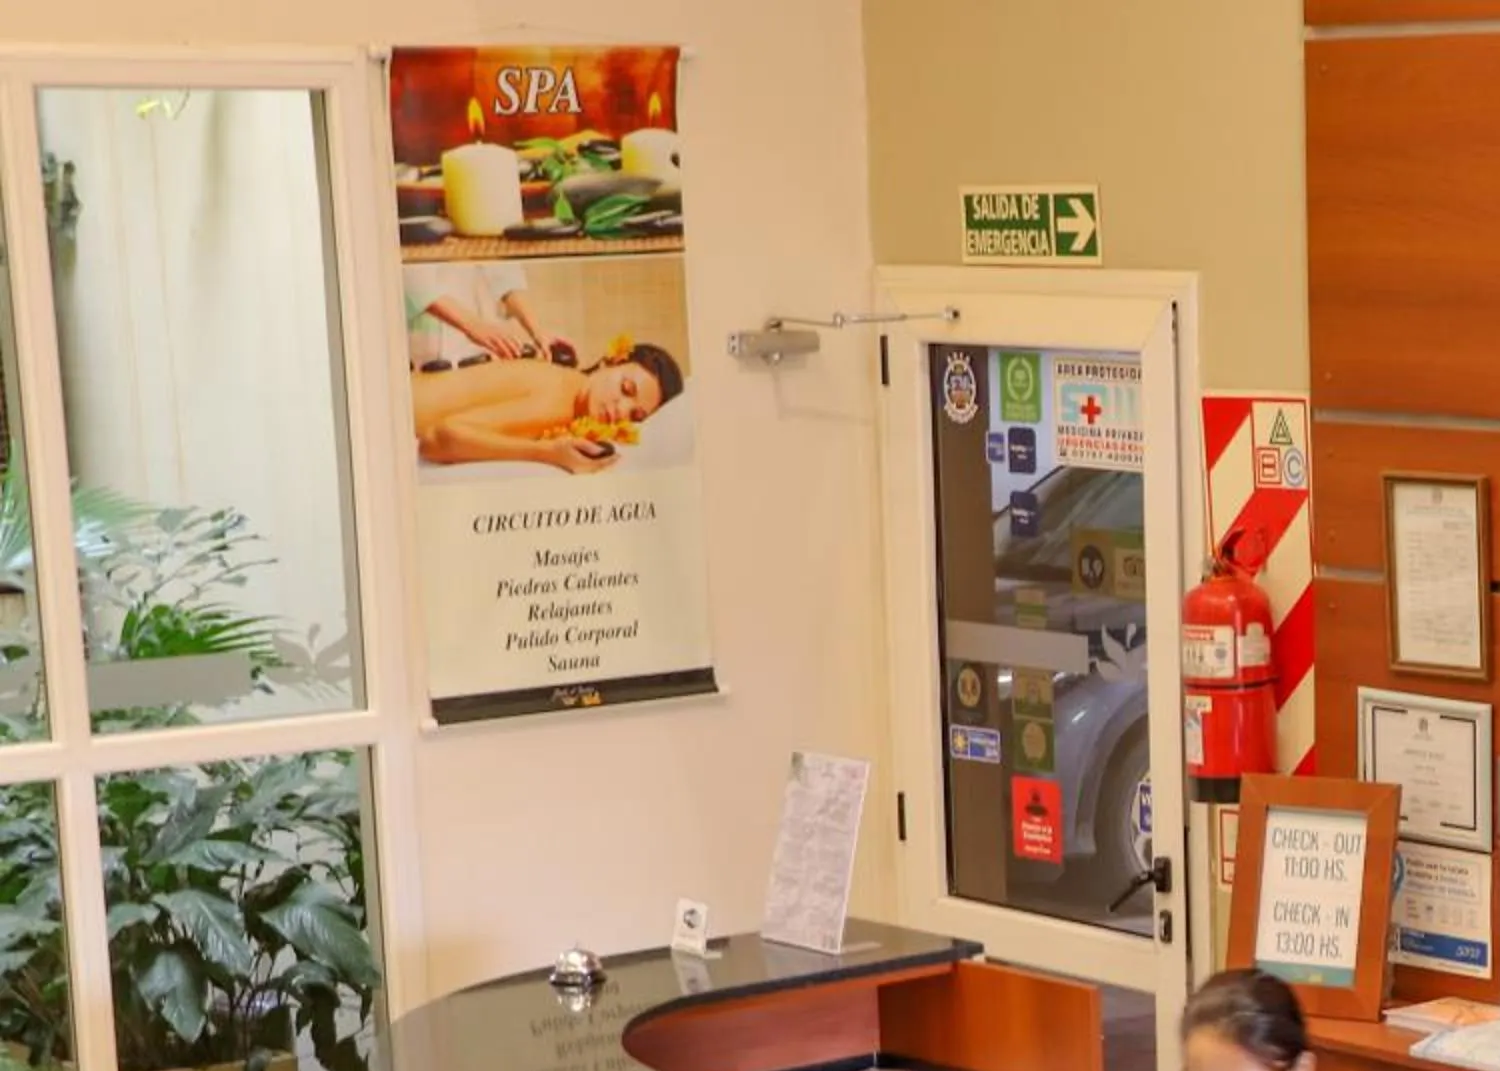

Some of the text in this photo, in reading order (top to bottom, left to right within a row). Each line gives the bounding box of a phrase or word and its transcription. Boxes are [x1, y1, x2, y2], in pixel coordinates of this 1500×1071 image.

[494, 65, 582, 115] SPA
[973, 194, 1040, 220] SALIDA DE
[967, 230, 1050, 254] EMERGENCIA
[473, 501, 657, 535] CIRCUITO DE AGUA
[533, 546, 600, 569] Masajes
[496, 571, 640, 599] Piedras Calientes
[527, 600, 613, 623] Relajantes
[505, 620, 639, 651] Pulido Corporal
[548, 653, 601, 674] Sauna
[1272, 827, 1319, 851] CHECK
[1333, 831, 1363, 855] OUT
[1284, 857, 1349, 882] 11:00 HS.
[1273, 901, 1321, 926] CHECK
[1334, 906, 1350, 929] IN
[1275, 932, 1343, 960] 13:00 HS.
